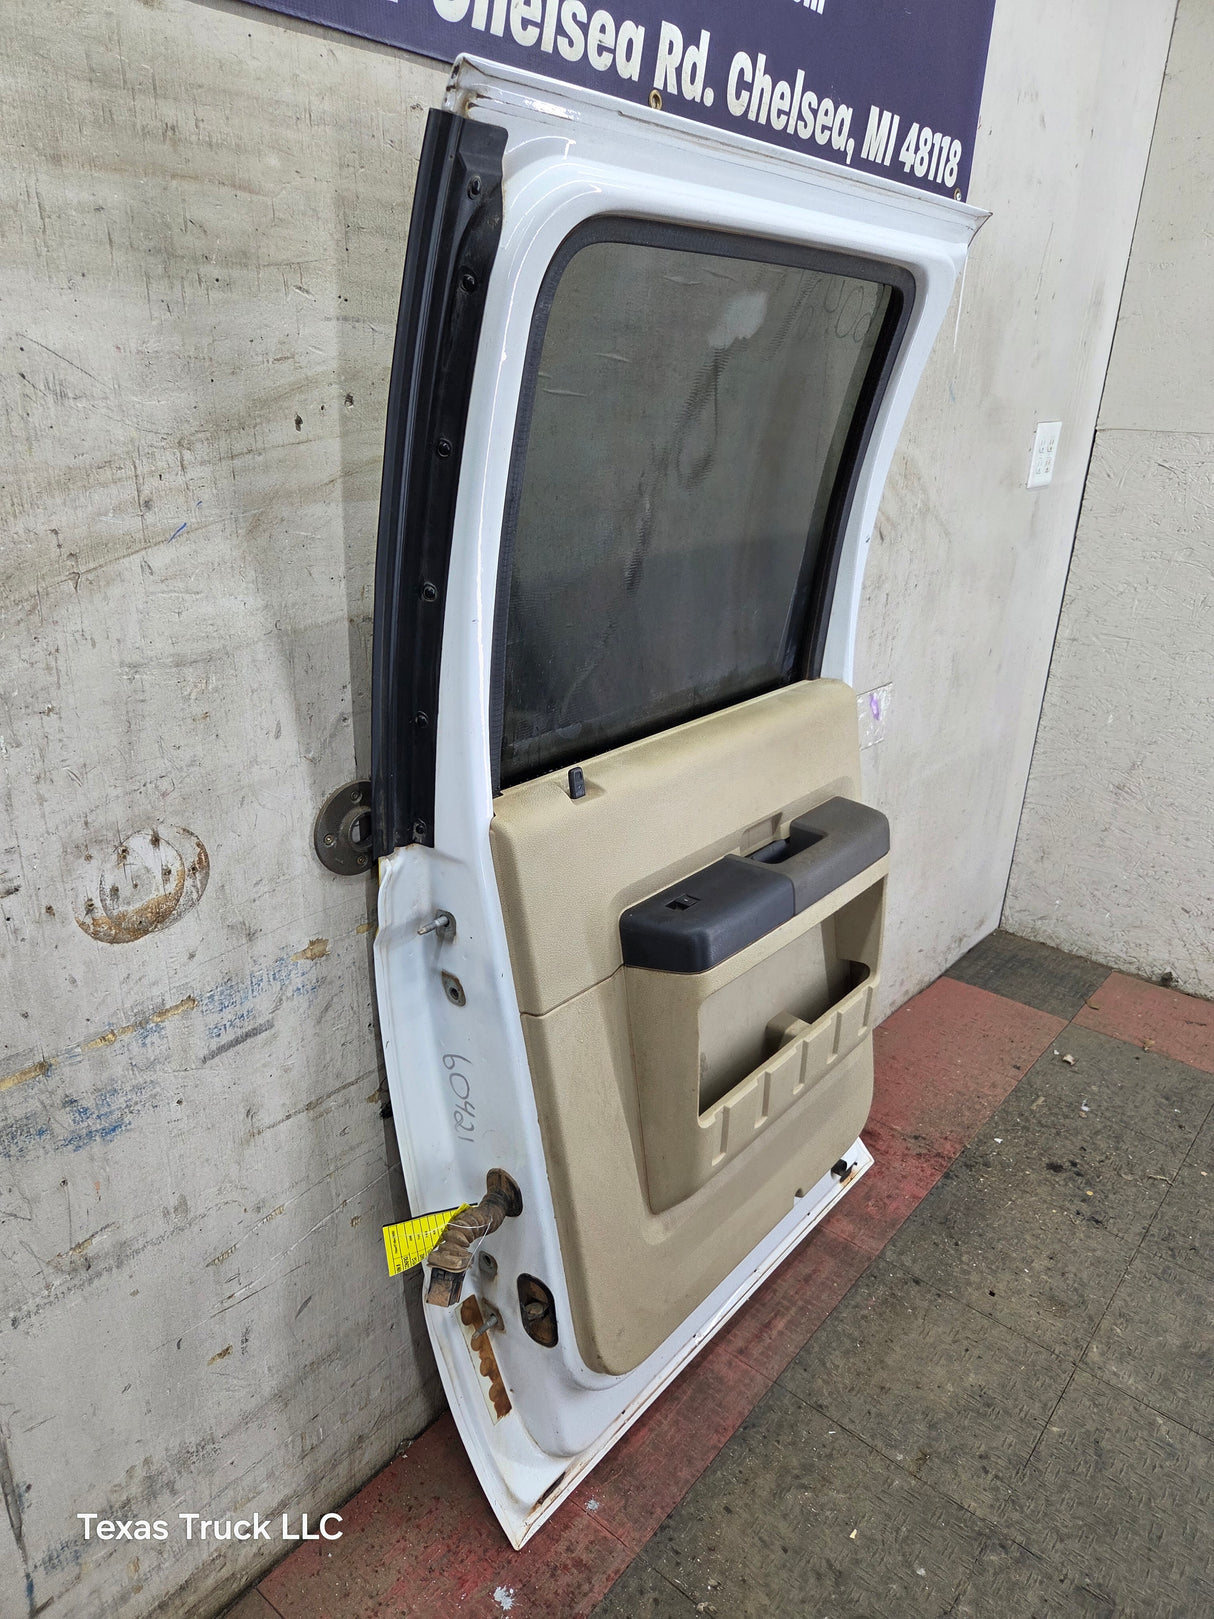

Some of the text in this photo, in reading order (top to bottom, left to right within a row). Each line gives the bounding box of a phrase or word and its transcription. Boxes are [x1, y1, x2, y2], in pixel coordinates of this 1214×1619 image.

[433, 0, 962, 188] elsea Rd. Chelsea, MI 48118
[442, 1053, 476, 1142] 60421
